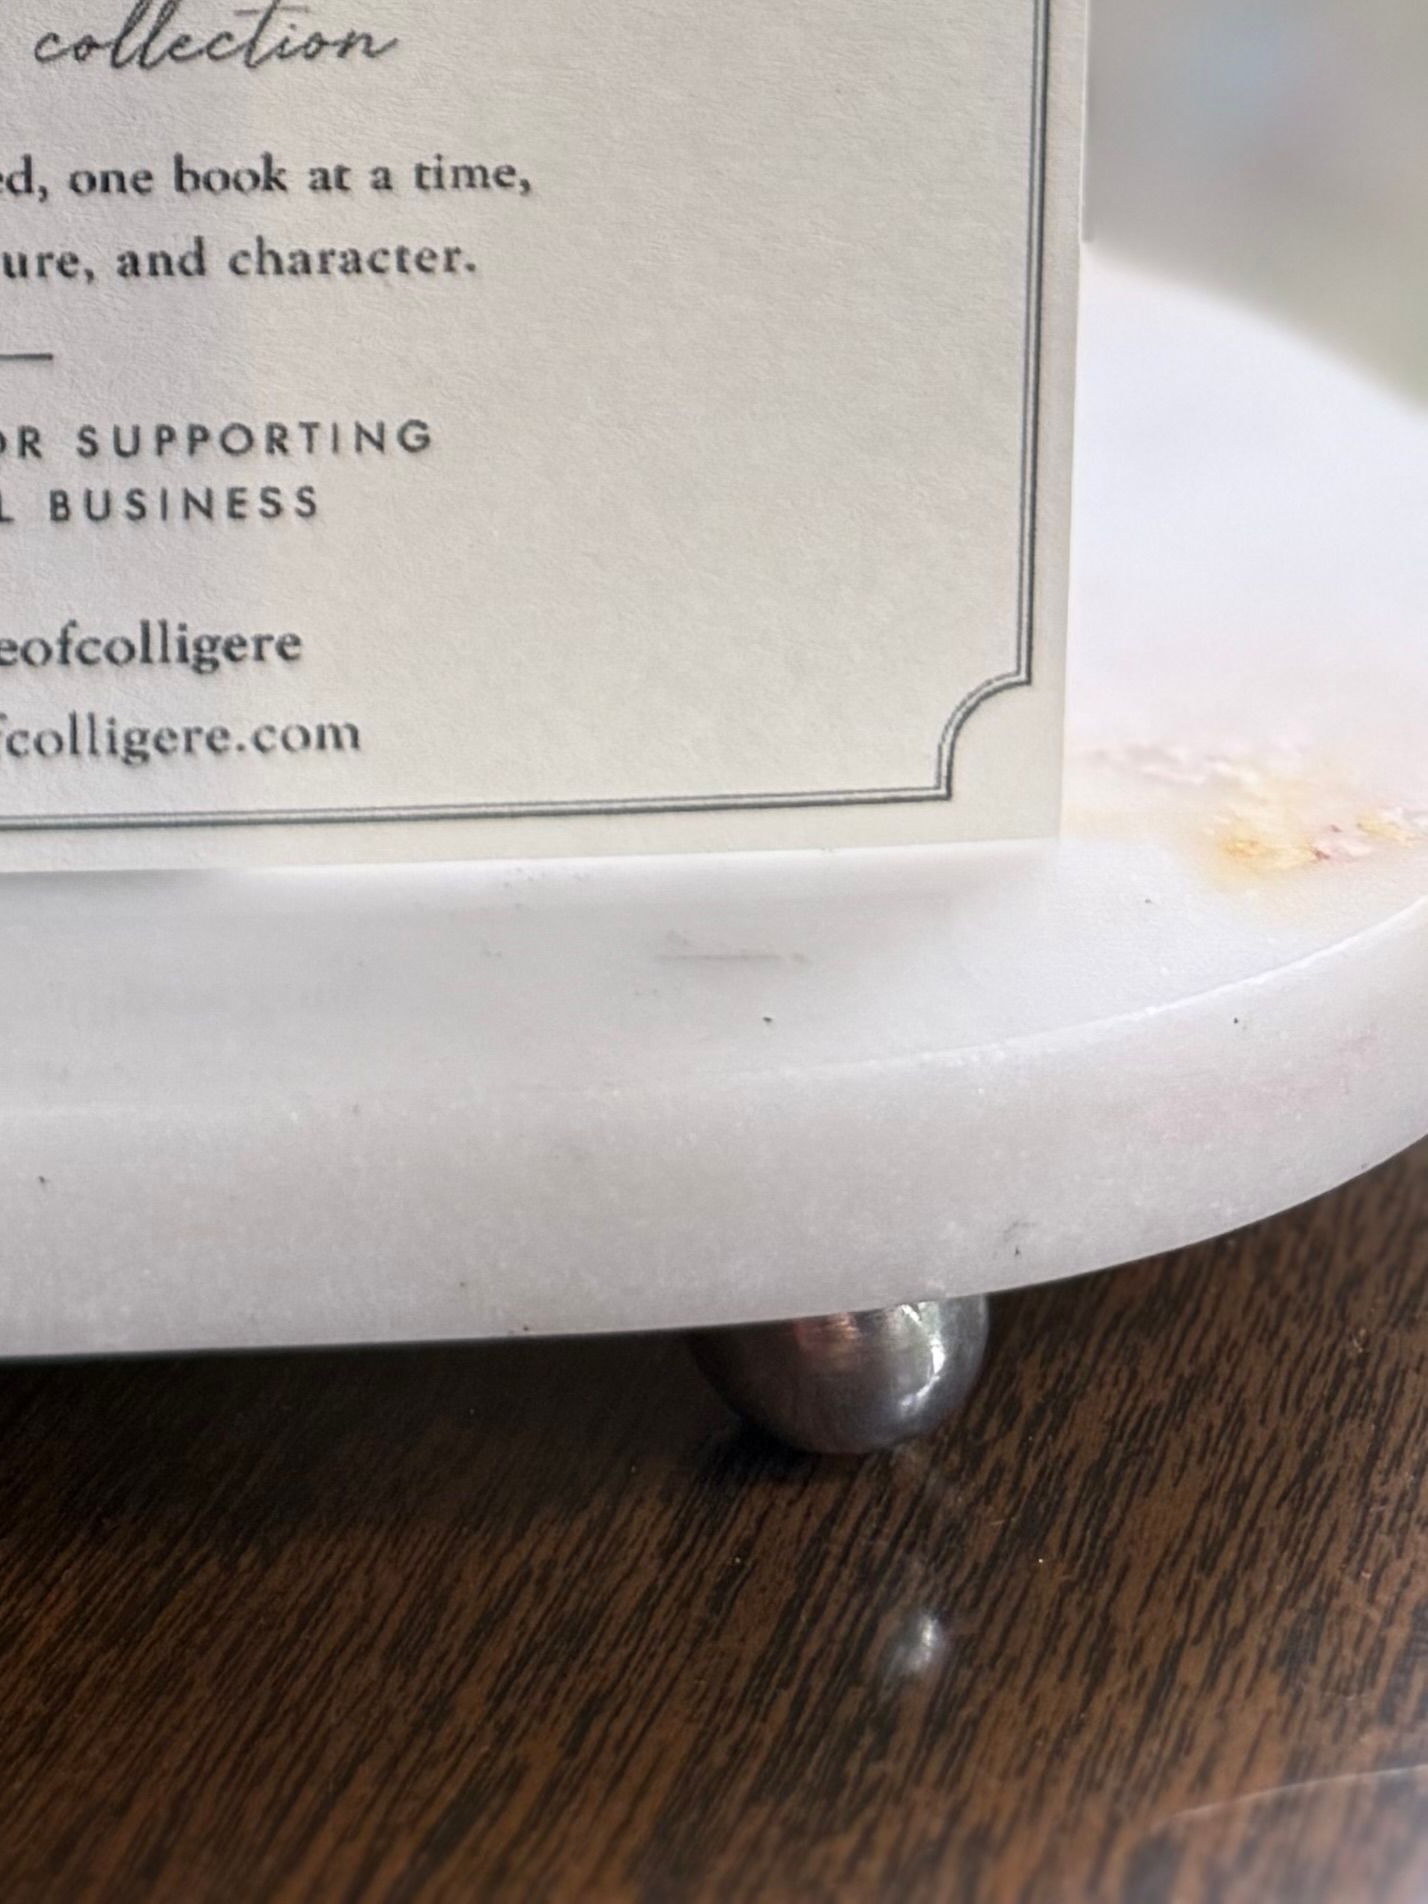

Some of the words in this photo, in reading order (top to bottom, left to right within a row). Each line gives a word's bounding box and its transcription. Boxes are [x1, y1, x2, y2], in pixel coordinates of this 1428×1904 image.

[67, 165, 155, 194] one
[172, 151, 289, 193] book
[307, 165, 353, 193] at
[369, 165, 396, 192] a
[412, 152, 533, 195] time,
[115, 234, 208, 279] and
[227, 234, 479, 280] character.
[76, 418, 436, 459] SUPPORTING
[48, 484, 322, 523] BUSINESS
